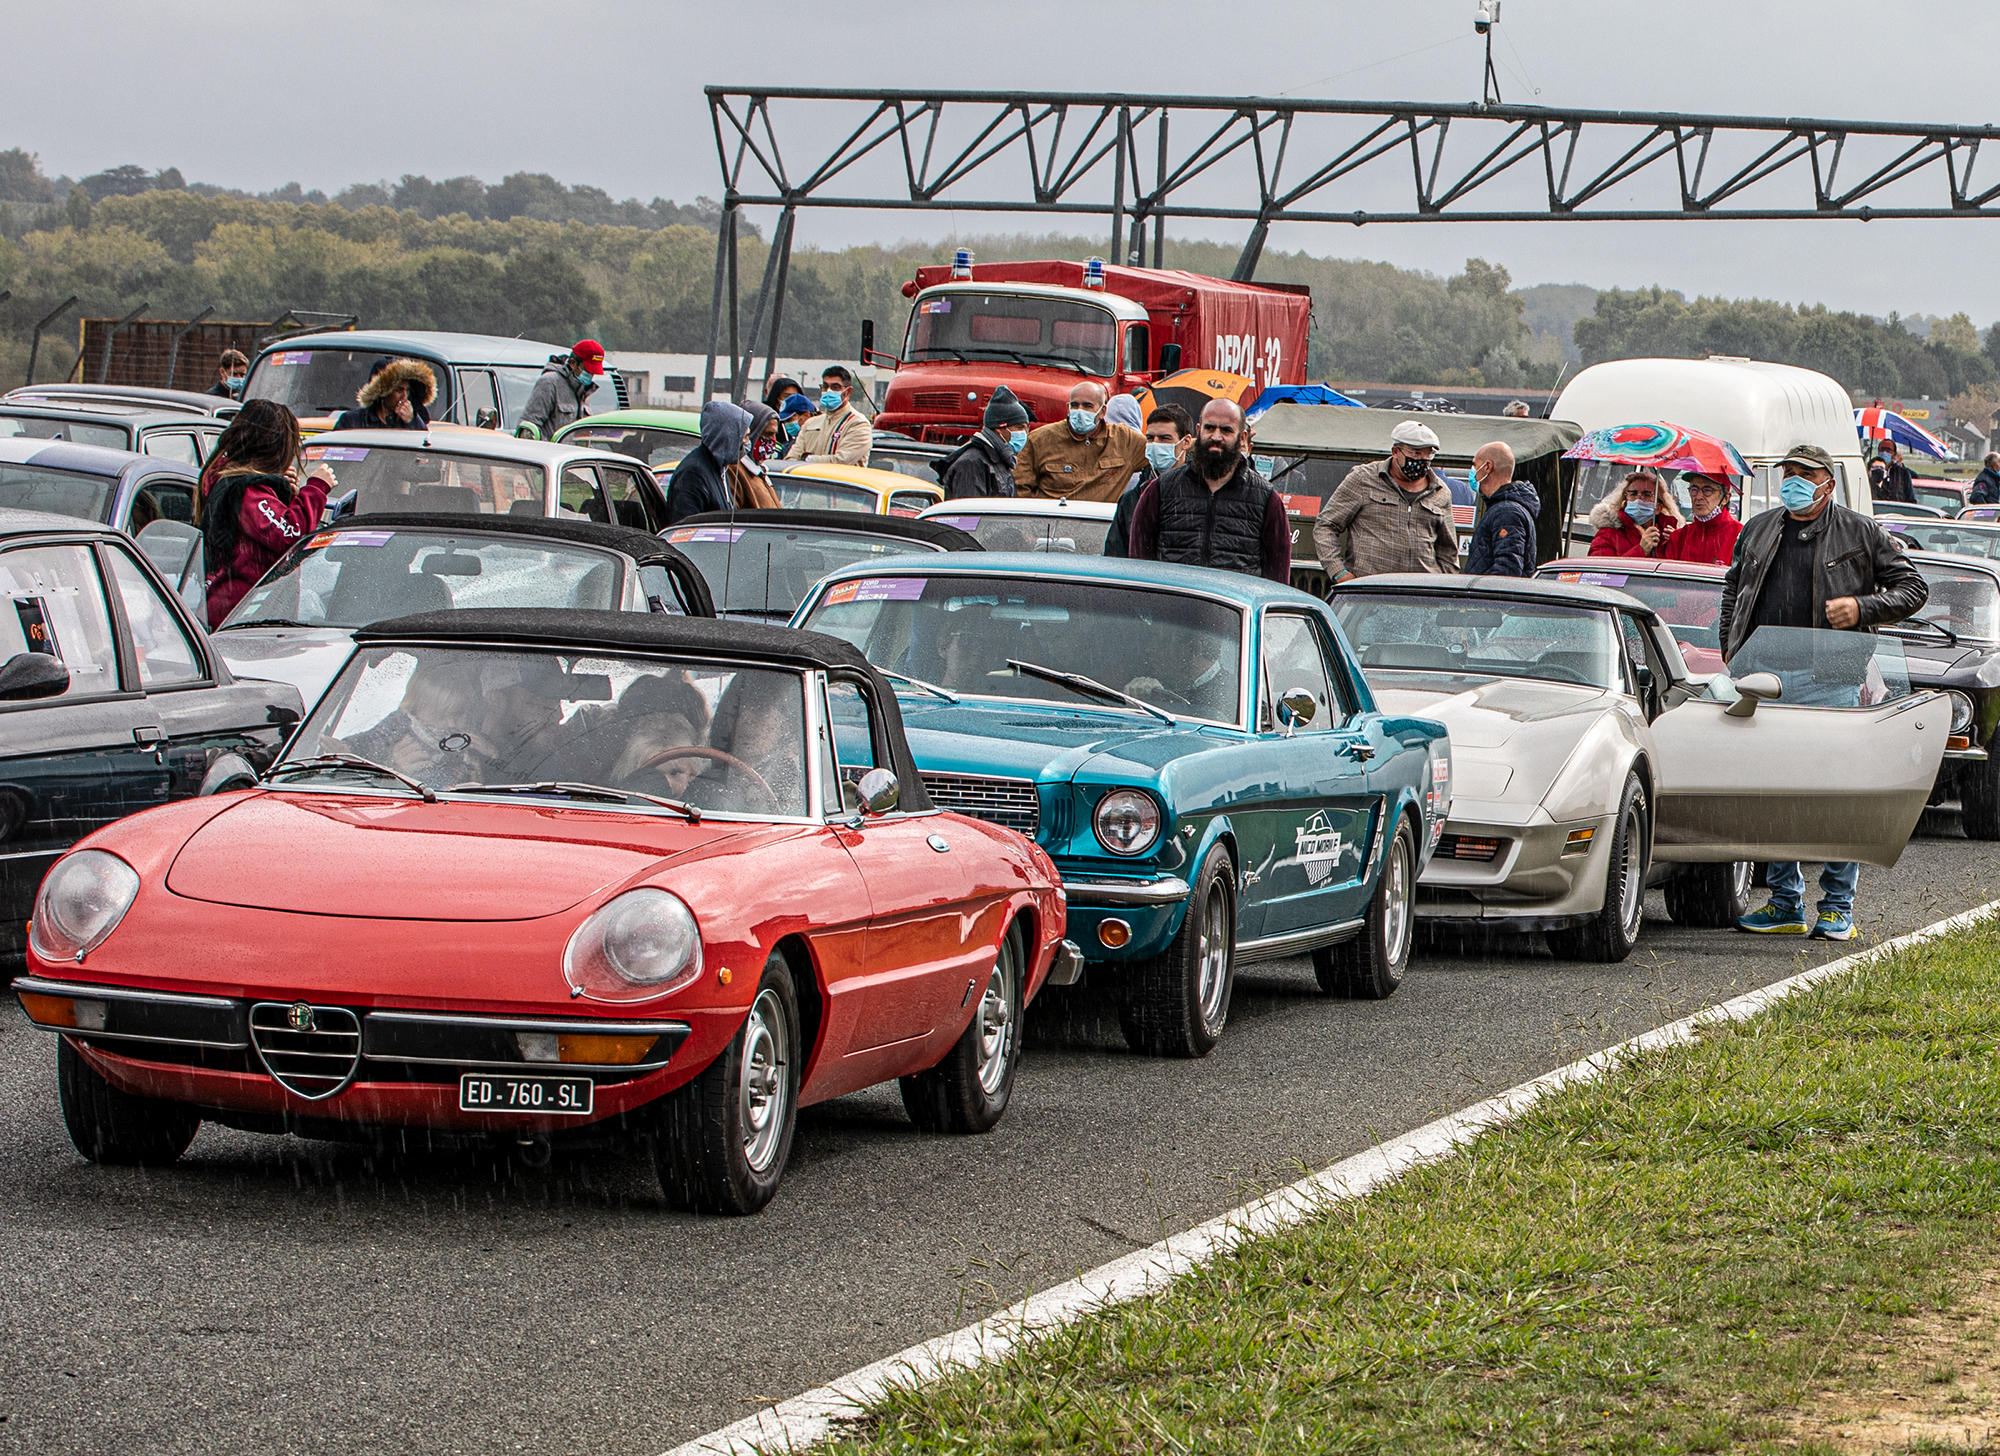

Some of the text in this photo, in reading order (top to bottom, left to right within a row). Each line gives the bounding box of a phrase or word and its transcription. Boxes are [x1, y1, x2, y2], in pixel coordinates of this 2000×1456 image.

[1214, 333, 1281, 388] DEPOL-32
[1299, 838, 1339, 856] NICO MOBILE
[467, 1081, 582, 1107] ED-760-SL
